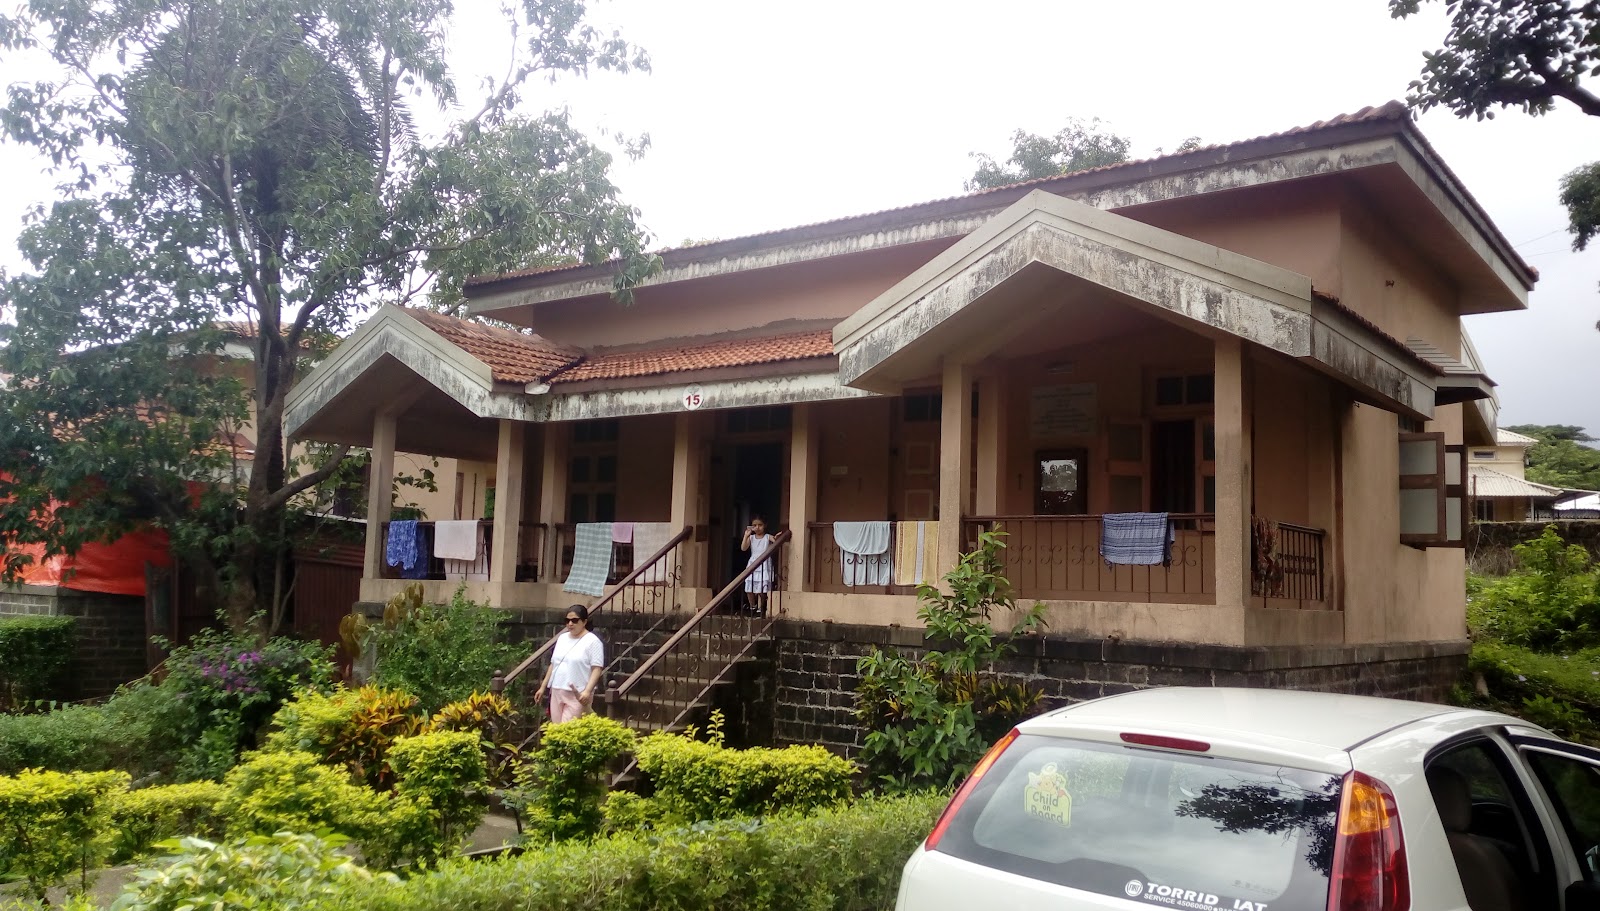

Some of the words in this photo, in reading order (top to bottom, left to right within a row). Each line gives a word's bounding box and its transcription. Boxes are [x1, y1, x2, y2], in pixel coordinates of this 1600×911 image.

[685, 394, 700, 406] 15
[1032, 791, 1058, 807] Child
[1031, 805, 1064, 824] Board
[1143, 892, 1176, 905] SERVICE
[1147, 882, 1219, 906] TORRID
